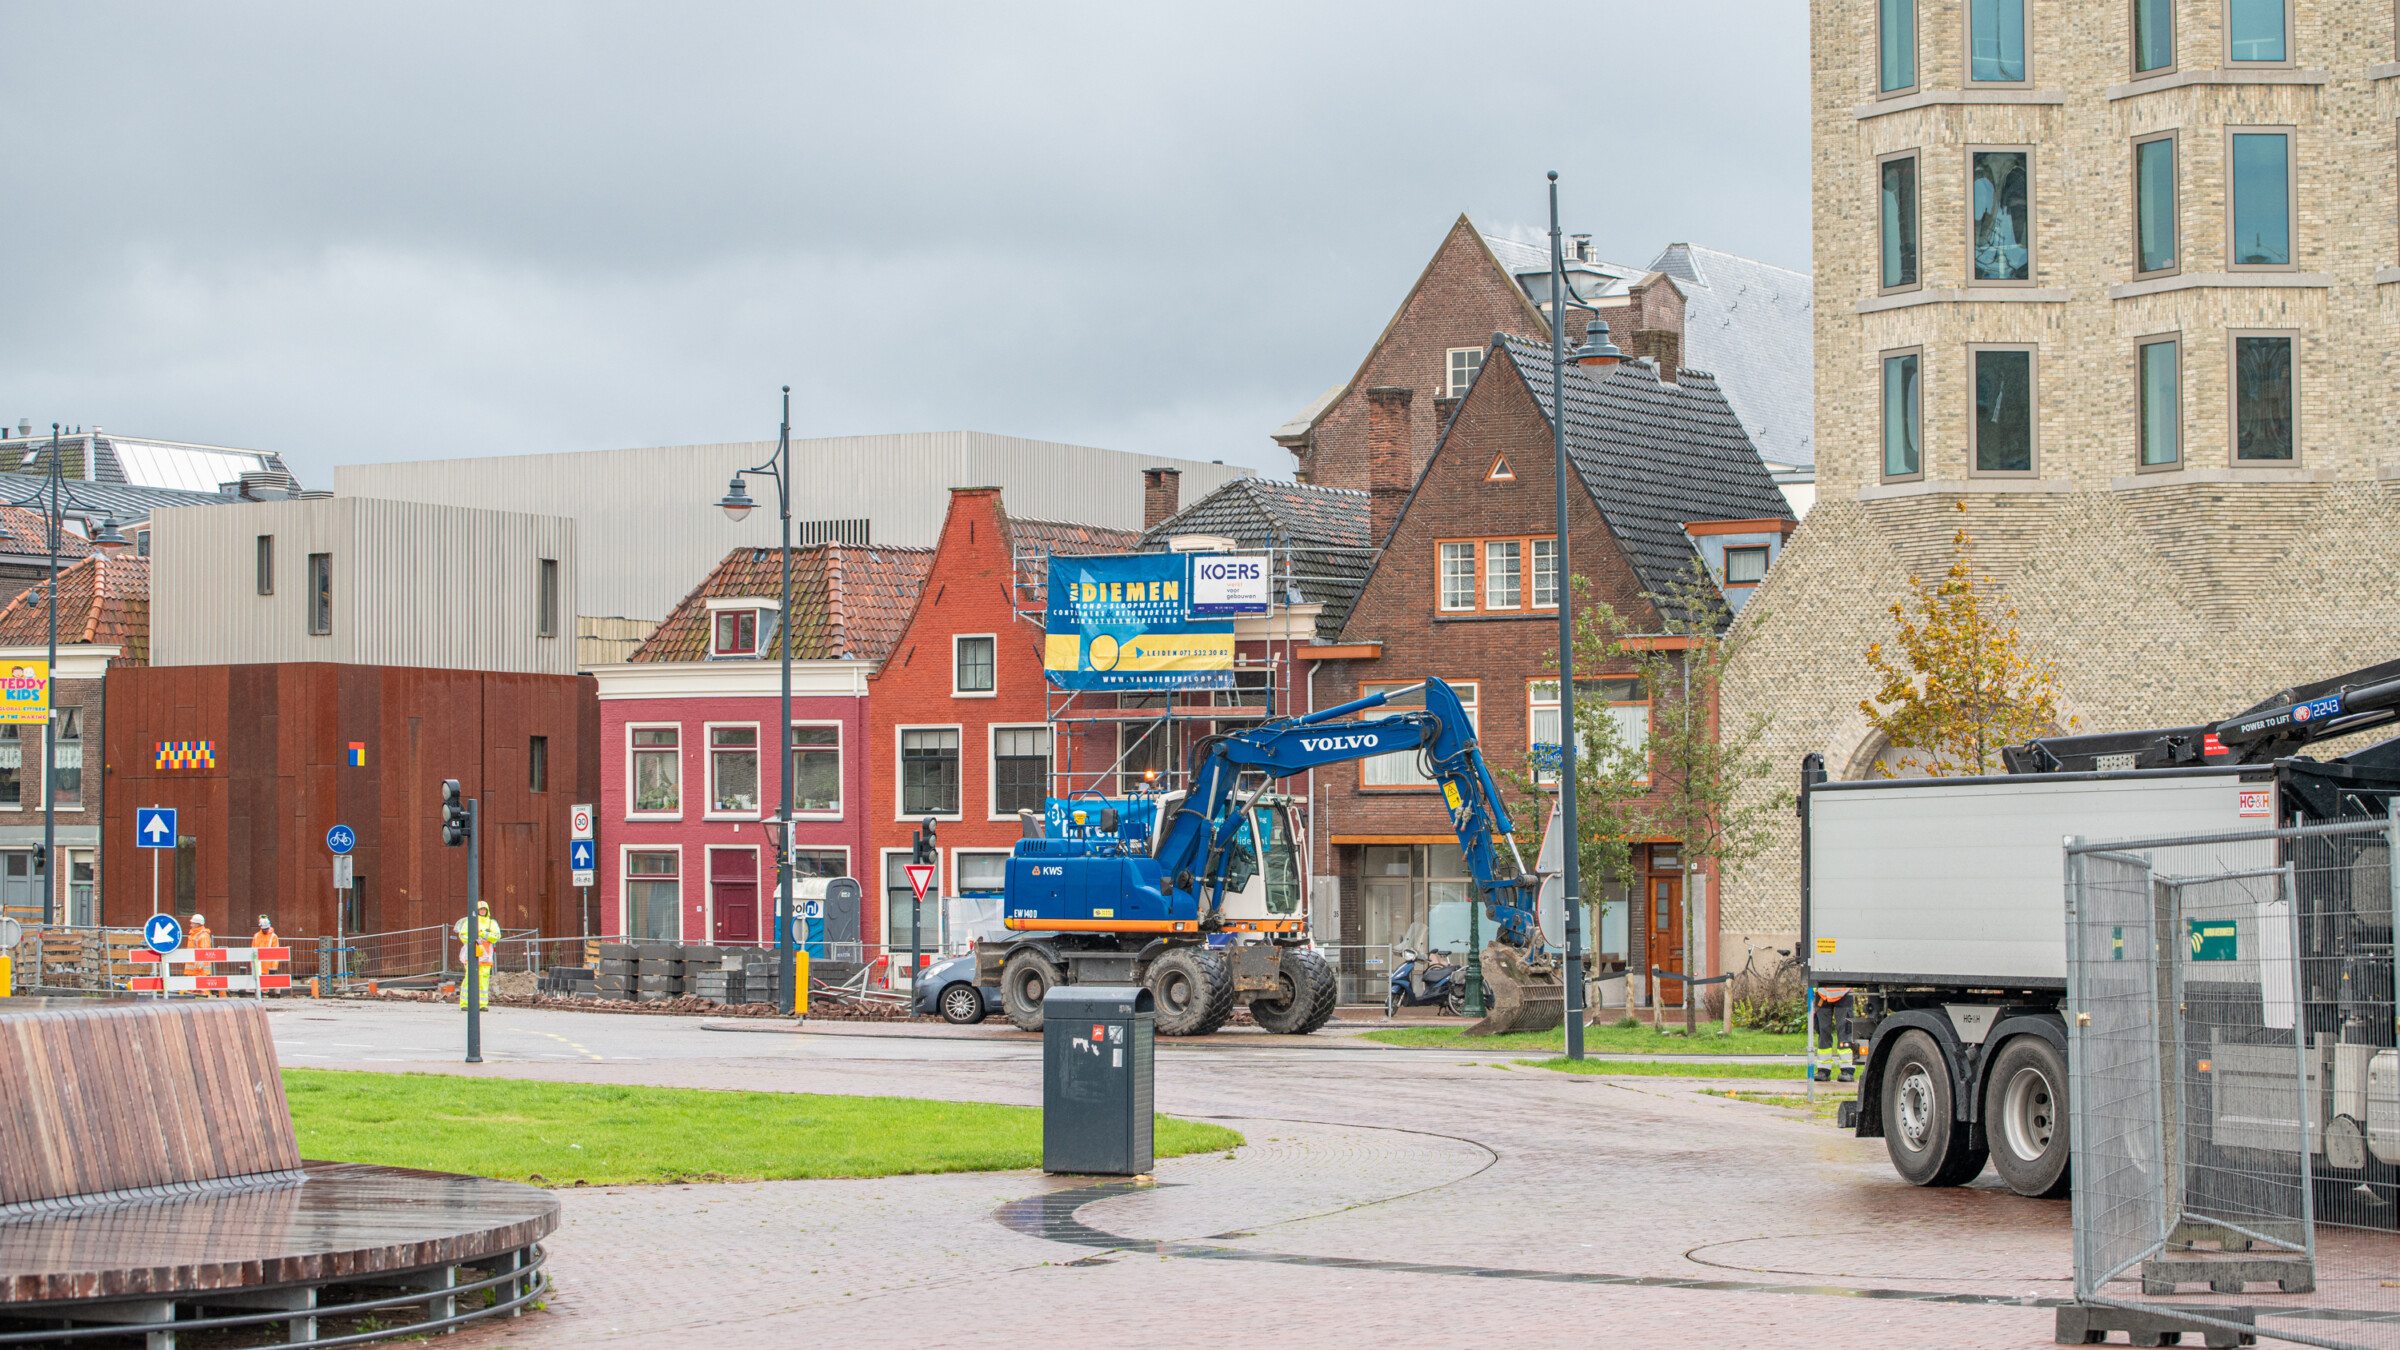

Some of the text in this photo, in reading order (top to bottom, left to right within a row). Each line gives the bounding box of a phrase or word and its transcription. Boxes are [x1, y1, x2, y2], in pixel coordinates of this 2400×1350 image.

[1201, 564, 1260, 580] KOERS
[1070, 583, 1078, 602] VAN
[1081, 581, 1179, 602] DIEMEN
[0, 678, 47, 689] TEDDY
[6, 689, 40, 701] KIDS
[2241, 721, 2265, 733] POWER
[2266, 718, 2276, 728] TO
[2276, 714, 2290, 726] LIFT
[2313, 699, 2339, 717] 2243
[1299, 734, 1379, 752] VOLVO
[577, 818, 587, 826] 30
[1042, 866, 1063, 876] KWS
